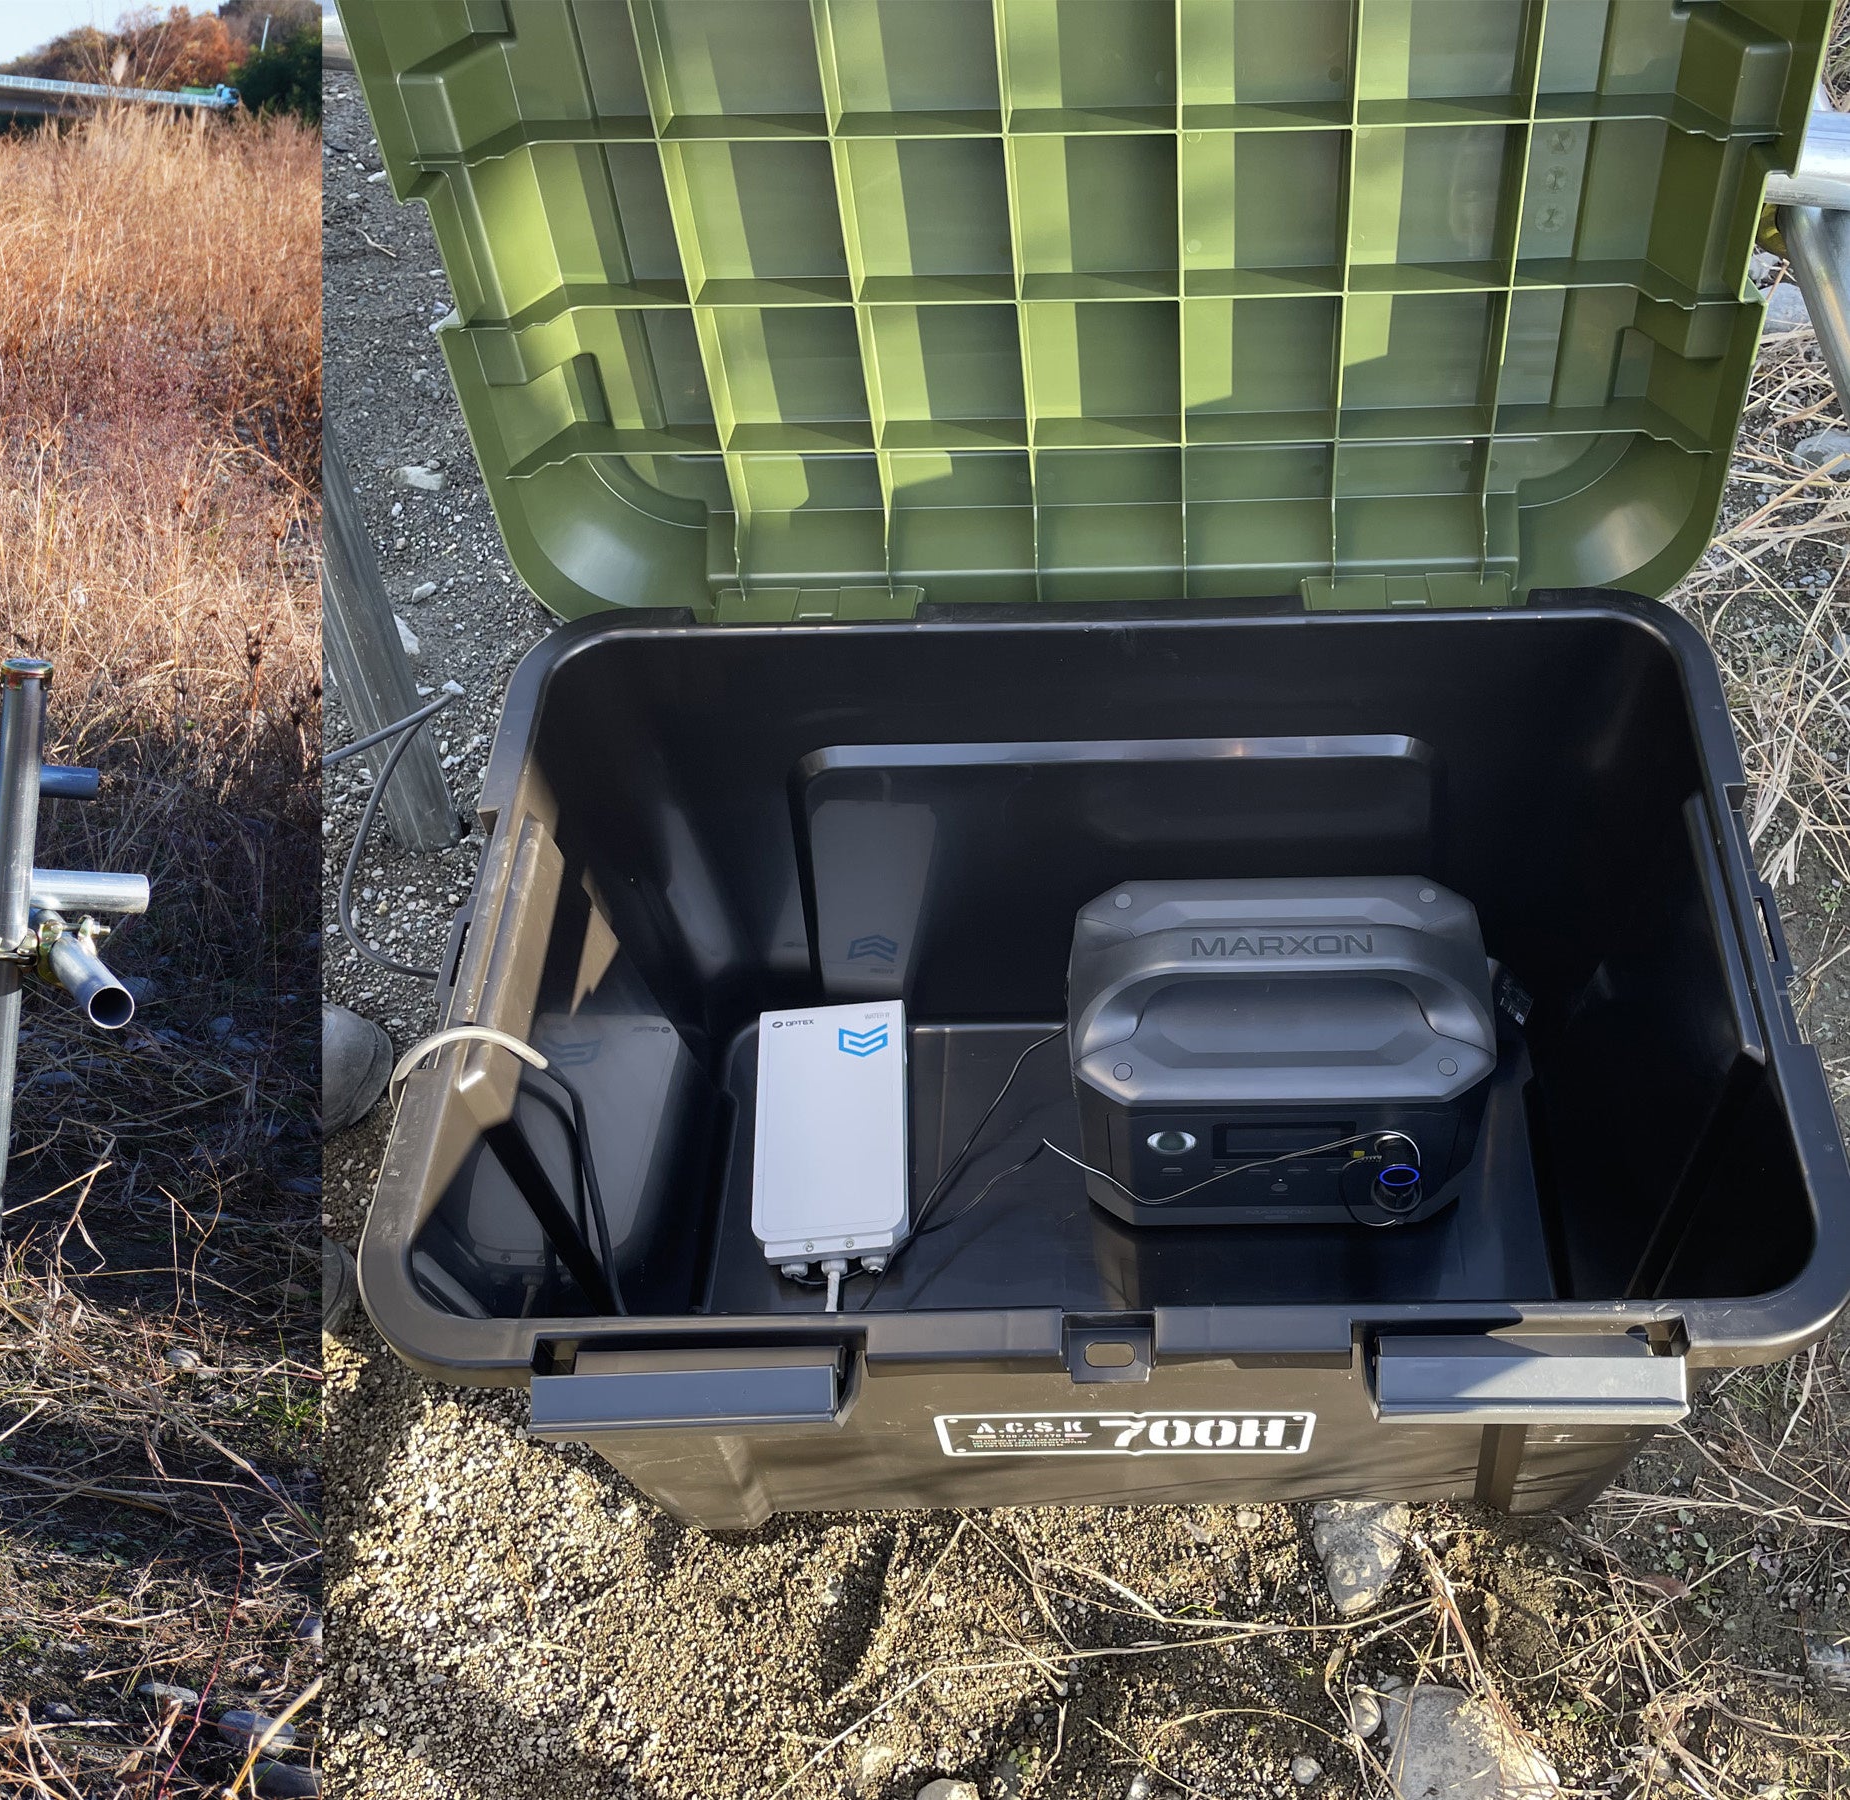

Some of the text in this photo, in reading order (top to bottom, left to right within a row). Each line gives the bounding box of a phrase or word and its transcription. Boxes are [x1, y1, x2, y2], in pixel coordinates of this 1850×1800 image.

[1191, 934, 1373, 956] MARXON
[785, 1019, 815, 1027] OPTEX
[976, 1419, 1286, 1447] A.C.S.K 700H
